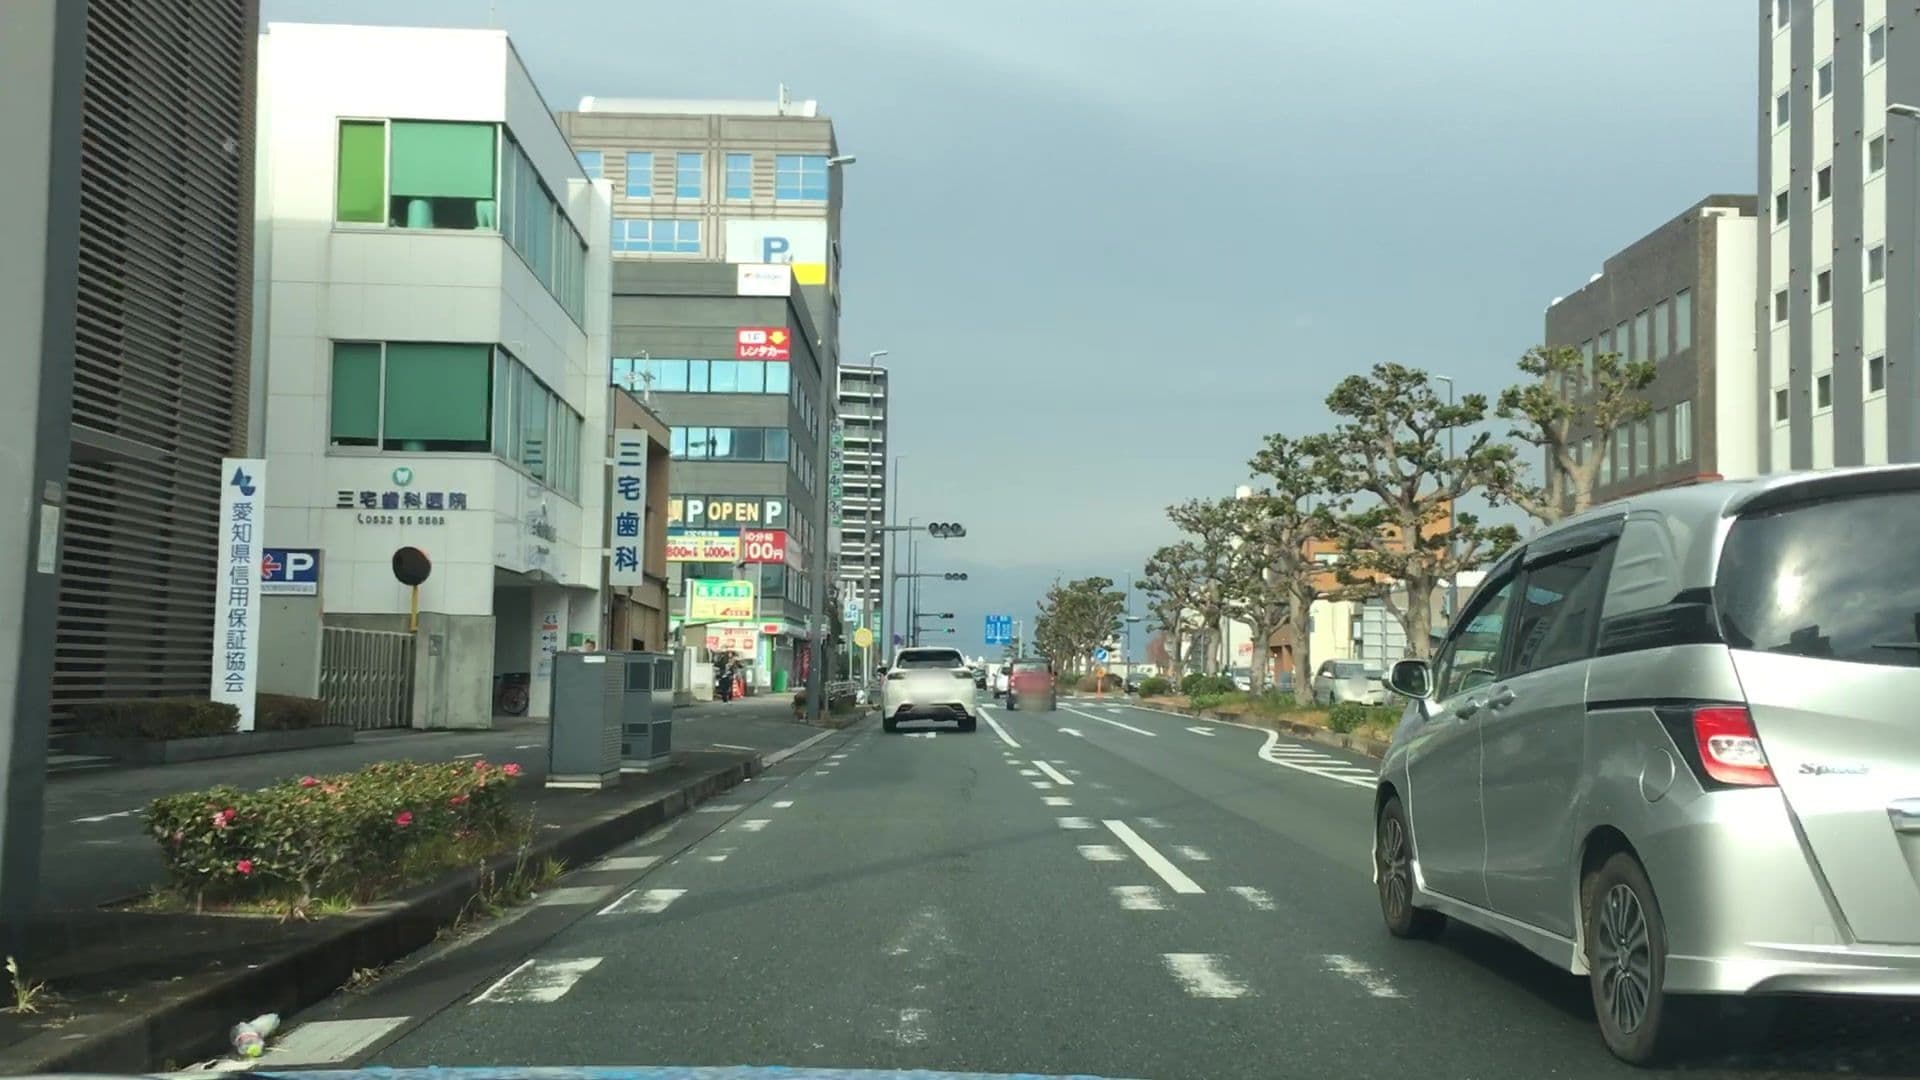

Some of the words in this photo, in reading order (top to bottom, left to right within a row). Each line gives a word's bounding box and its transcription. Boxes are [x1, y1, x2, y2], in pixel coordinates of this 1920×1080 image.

[763, 237, 789, 264] P
[740, 345, 788, 357] レンタカー
[336, 491, 467, 510] 三宅歯科医院
[615, 442, 641, 572] 三宅歯科
[687, 500, 704, 522] P
[708, 502, 759, 521] OPEN
[766, 501, 782, 524] P
[286, 553, 314, 580] P
[224, 501, 252, 693] 愛知県信用保証協会
